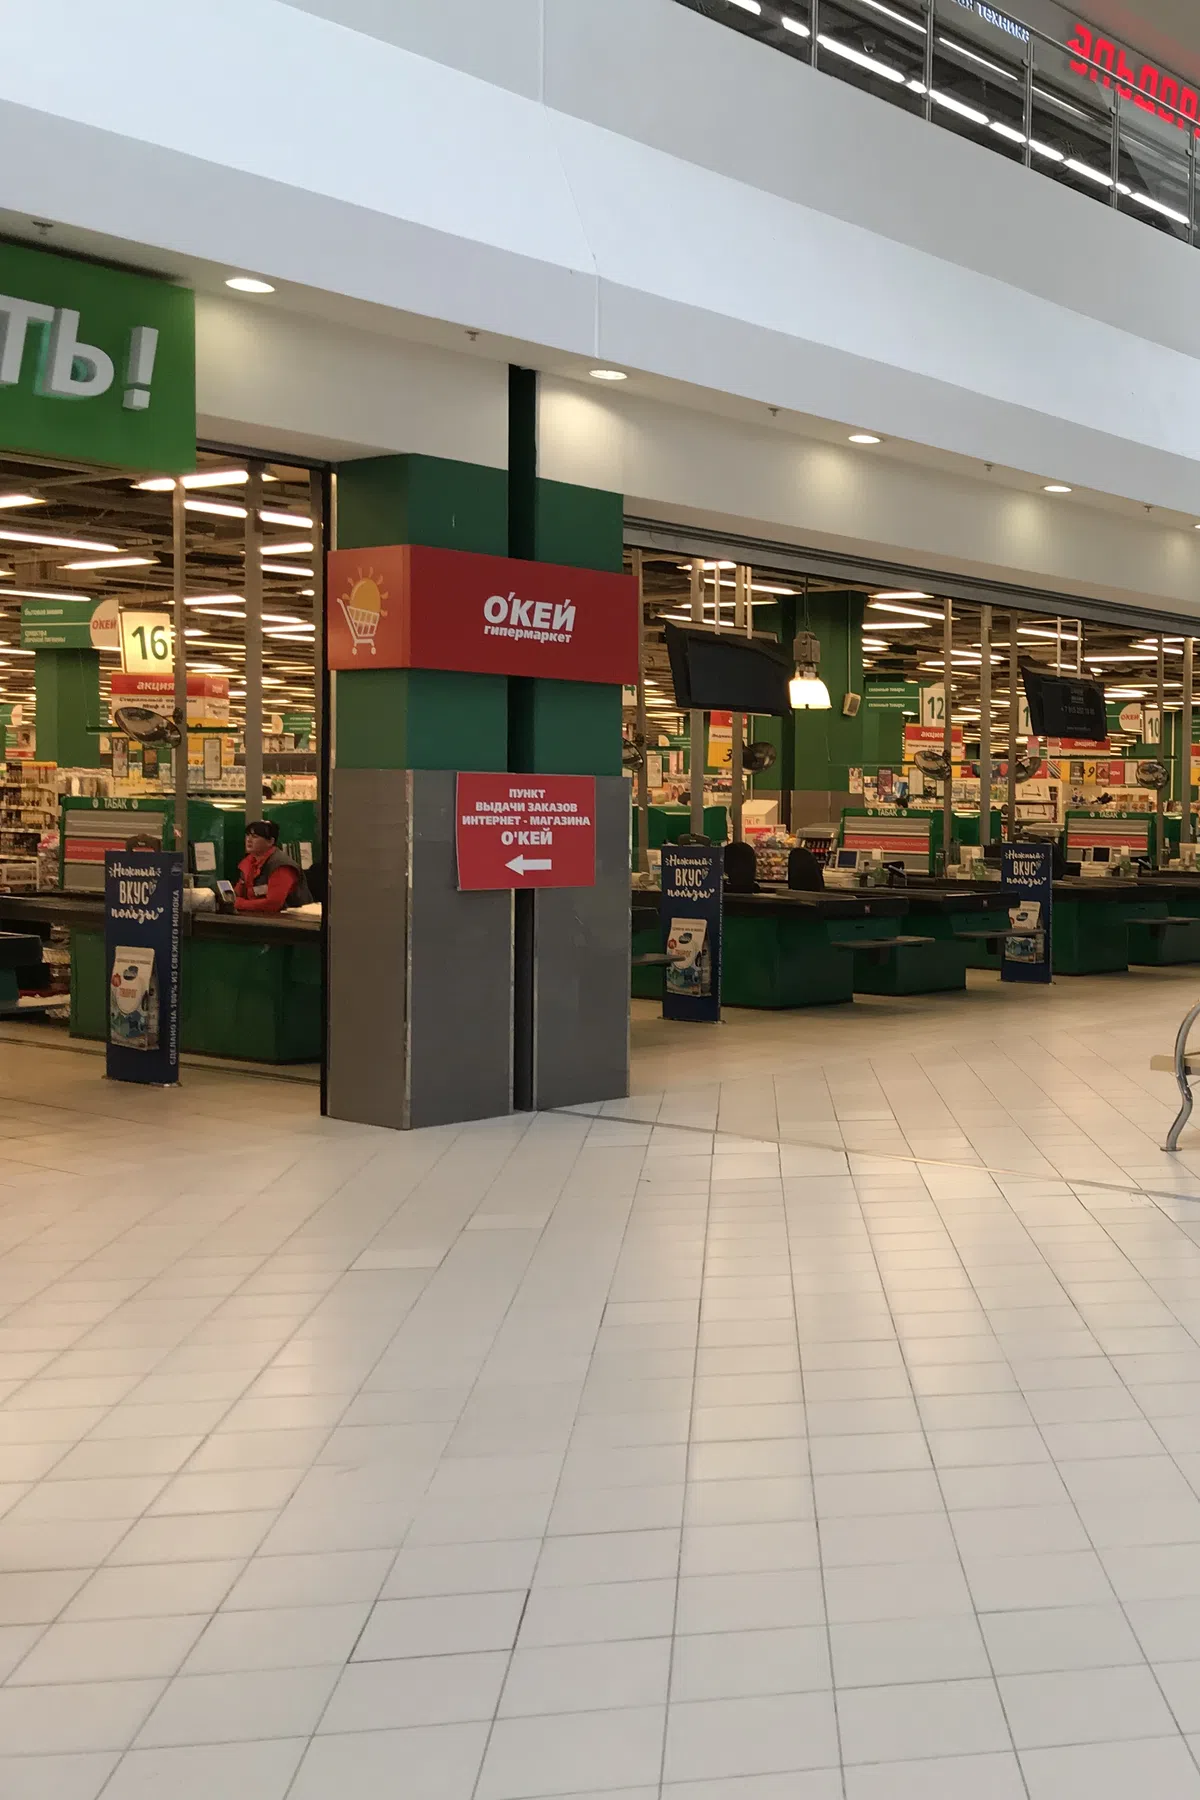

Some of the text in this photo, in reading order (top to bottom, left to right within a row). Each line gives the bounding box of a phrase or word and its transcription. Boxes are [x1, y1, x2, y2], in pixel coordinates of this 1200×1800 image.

[131, 625, 168, 660] 16
[484, 624, 572, 644] гипермаркет
[927, 696, 945, 721] 12
[1148, 717, 1159, 738] 10
[509, 788, 546, 799] ПУНКТ
[103, 798, 128, 810] ТАБАК
[475, 801, 578, 814] ВЫДАЧИ ЗАКАЗОВ
[877, 808, 898, 817] ТАБАК
[462, 815, 521, 826] ИНТЕРНЕТ
[529, 815, 591, 826] МАГАЗИНА
[501, 827, 553, 845] О'КЕЙ
[113, 862, 156, 878] Нежный
[1013, 860, 1037, 876] ВКУС
[675, 868, 702, 887] ВКУС
[119, 880, 149, 905] ВКУС
